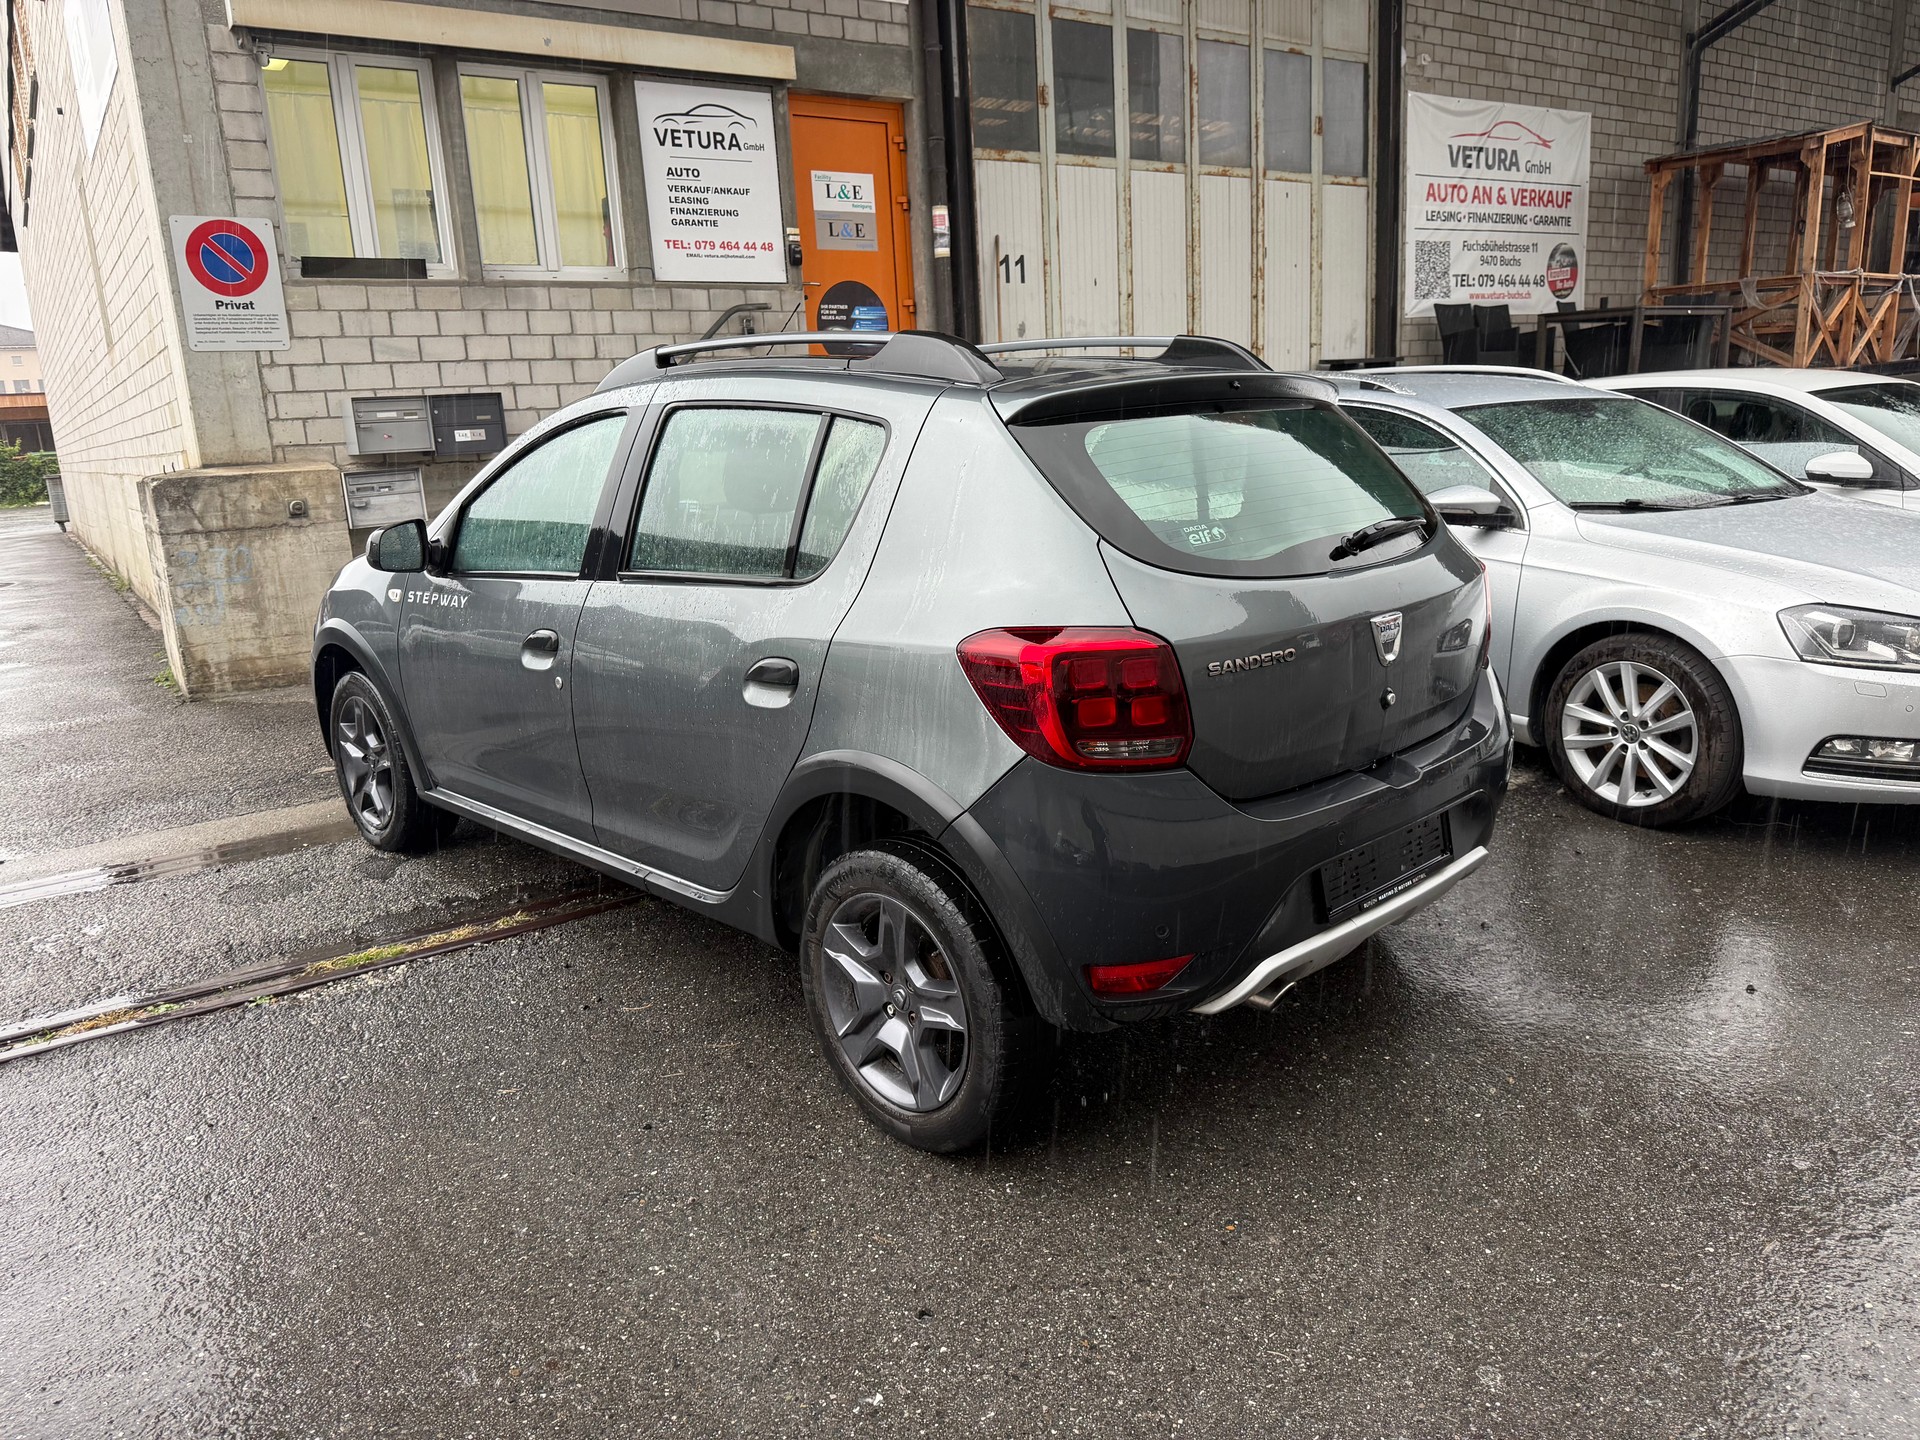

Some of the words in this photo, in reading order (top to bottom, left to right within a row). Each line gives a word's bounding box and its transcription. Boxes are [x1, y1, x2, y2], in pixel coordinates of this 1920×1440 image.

[653, 127, 742, 151] VETURA
[743, 142, 765, 151] GmbH
[1447, 144, 1520, 172] VETURA
[1525, 160, 1552, 174] GmbH
[666, 167, 700, 178] AUTO
[667, 185, 751, 196] VERKAUF/ANKAUF
[825, 183, 863, 200] L&E
[1425, 182, 1468, 204] AUTO
[1471, 185, 1493, 205] AN
[1496, 187, 1507, 205] &
[1511, 187, 1573, 209] VERKAUF
[668, 196, 709, 205] LEASING
[670, 207, 739, 217] FINANZIERUNG
[1425, 210, 1462, 223] LEASING
[1467, 212, 1528, 225] FINANZIERUNG
[1533, 215, 1572, 227] GARANTIE
[671, 218, 719, 227] GARANTIE
[828, 221, 866, 239] L&E
[664, 239, 691, 250] TEL:
[694, 240, 716, 250] 079
[719, 241, 740, 251] 464
[743, 242, 757, 251] 44
[760, 242, 774, 252] 48
[1462, 240, 1531, 253] Fuchsbühelstrasse
[1531, 242, 1538, 253] 11
[1480, 254, 1498, 266] 9470
[1499, 255, 1522, 267] Buchs
[999, 254, 1026, 284] 11
[1453, 274, 1476, 288] TEL:
[1477, 274, 1496, 288] 079
[1498, 274, 1517, 288] 464
[1518, 275, 1532, 288] 44
[1533, 274, 1546, 288] 48
[215, 300, 255, 310] Privat
[1183, 524, 1208, 533] DACIA
[1188, 530, 1211, 544] elf
[407, 591, 468, 608] STEPWAY
[1380, 622, 1400, 632] DACIA
[1207, 648, 1297, 677] SANDERO
